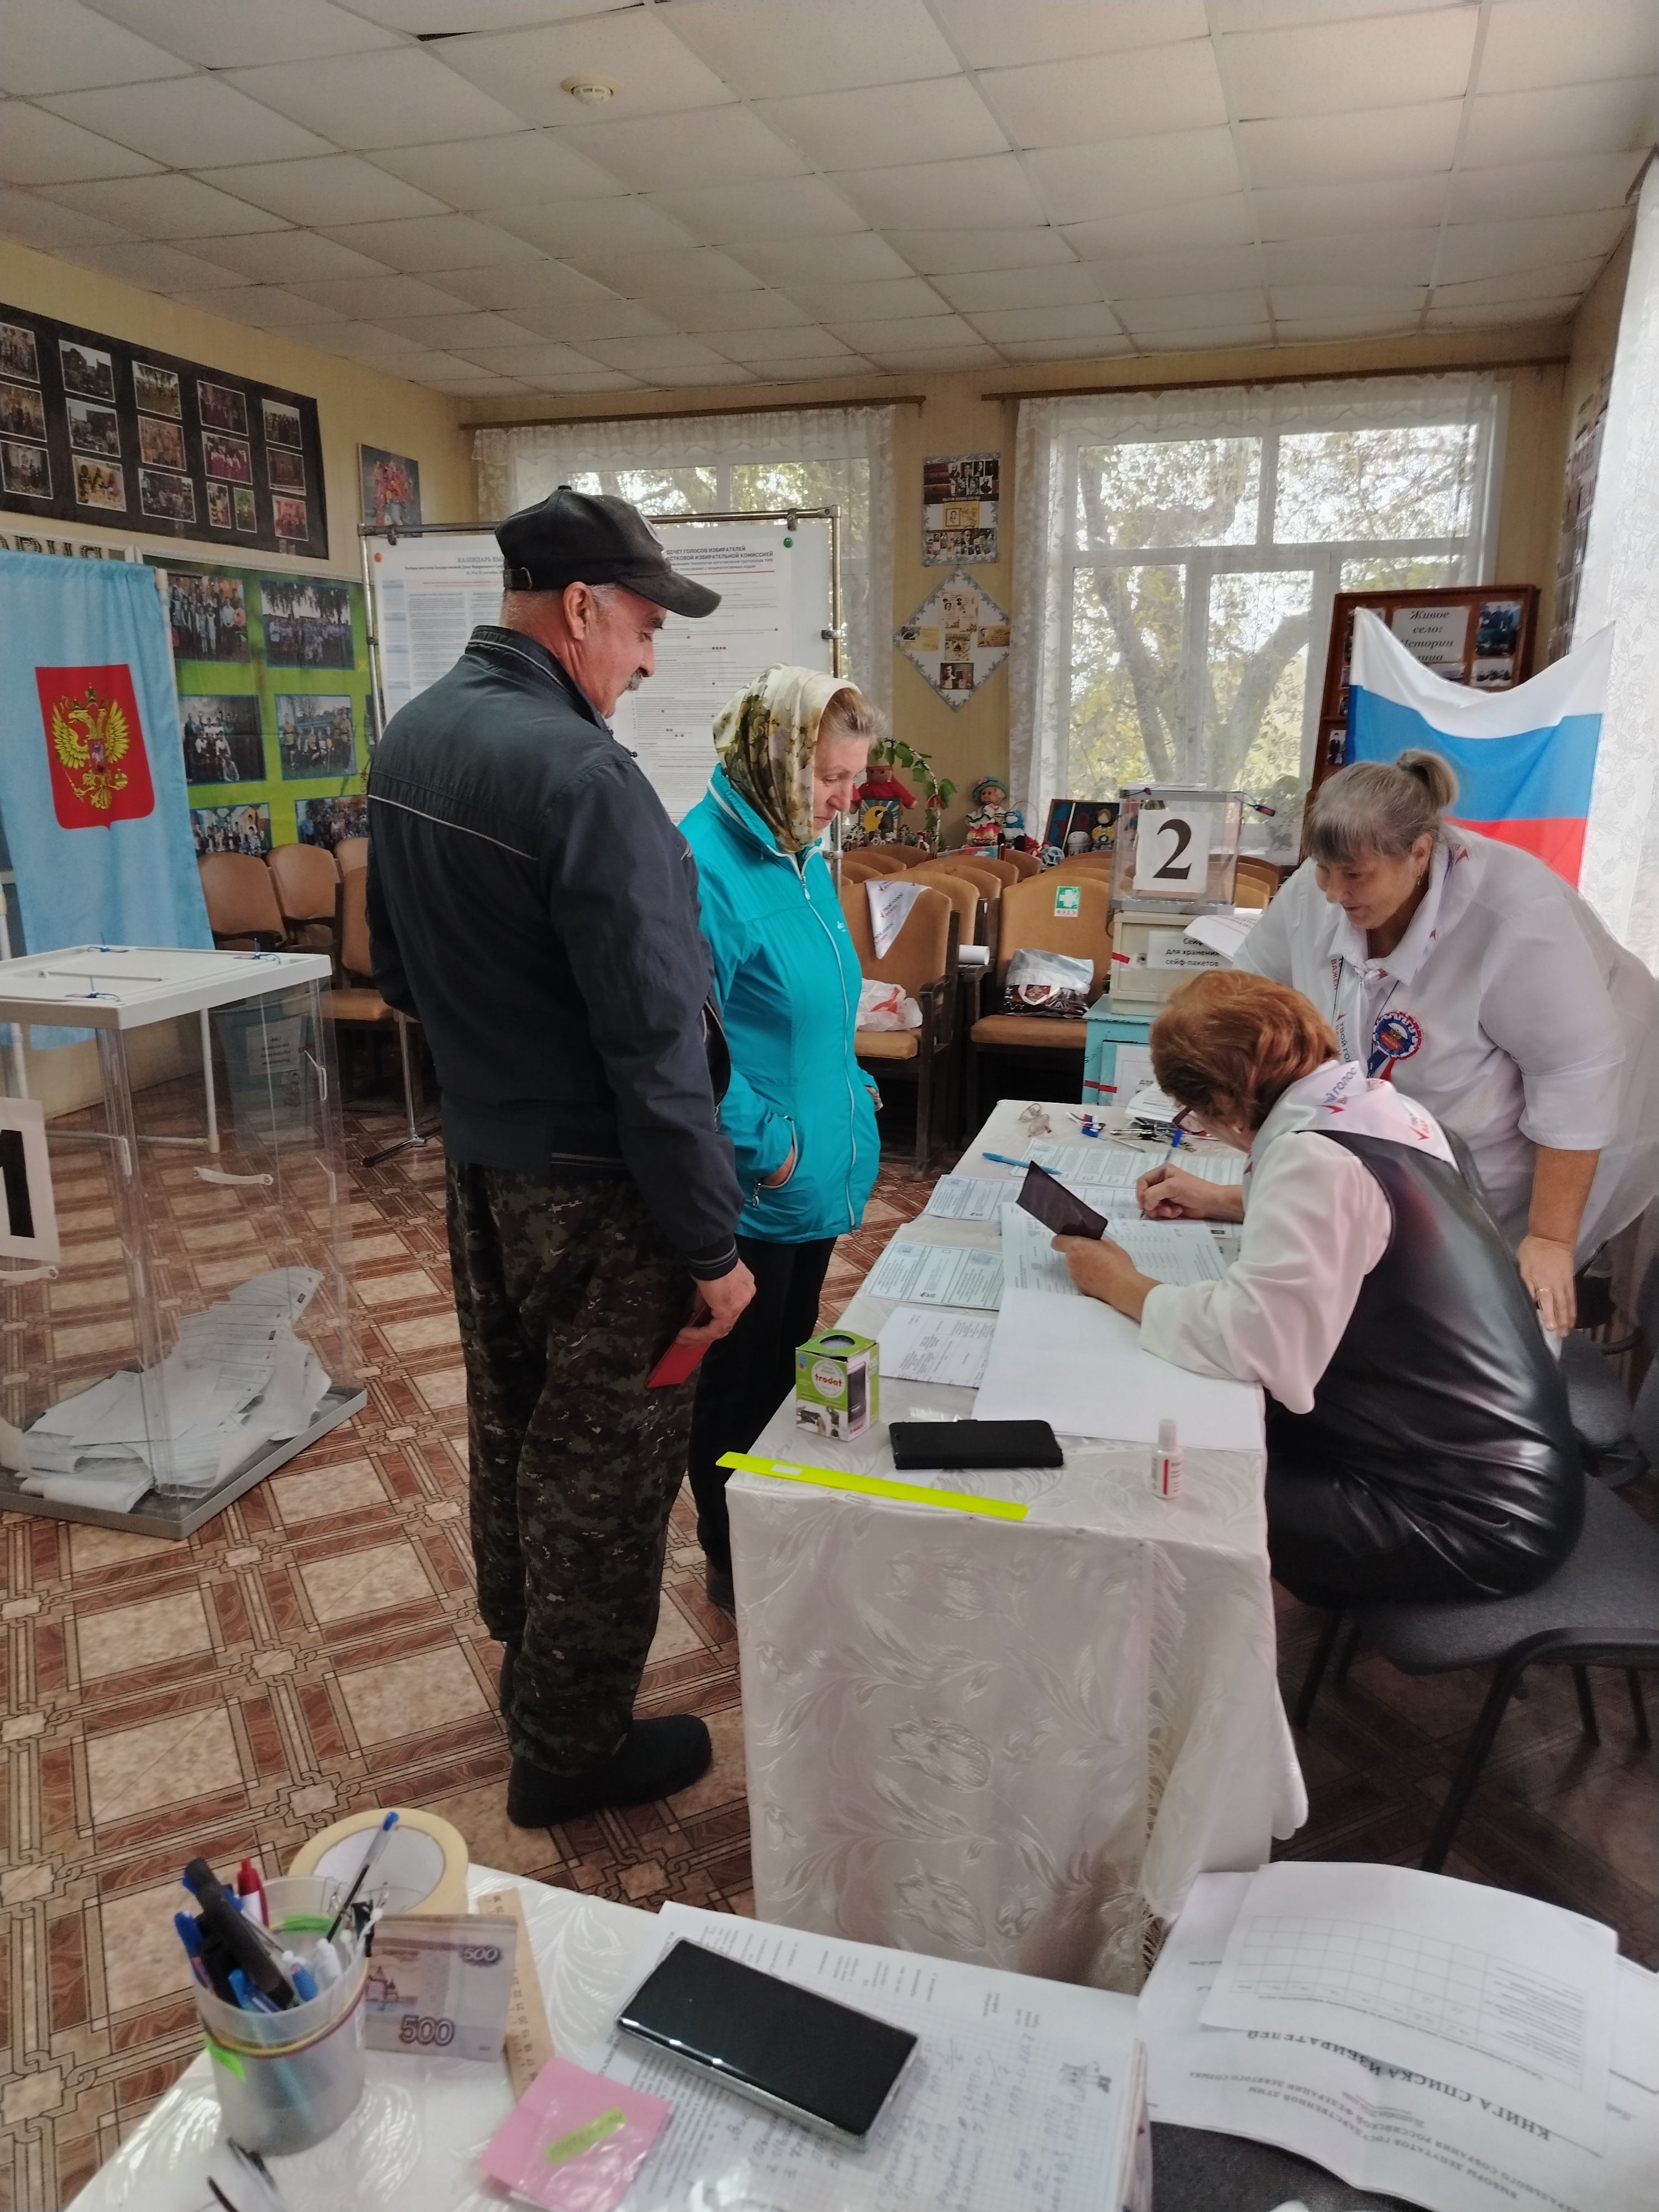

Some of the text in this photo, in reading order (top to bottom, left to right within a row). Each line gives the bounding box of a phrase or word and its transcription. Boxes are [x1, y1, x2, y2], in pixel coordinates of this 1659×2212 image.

[1409, 610, 1449, 619] Живое
[1152, 818, 1193, 880] 2
[1183, 938, 1203, 947] Сейф
[1165, 958, 1219, 967] сейф-пакетов
[1332, 1067, 1357, 1095] ГОЛОС
[0, 1129, 35, 1239] 1
[815, 1373, 842, 1387] trodat
[462, 1948, 497, 1961] 500
[399, 2013, 456, 2046] 500
[1246, 2030, 1382, 2077] ИЗБИРАТЕЛЕЙ
[1189, 2072, 1229, 2080] СОЗЫВА
[1230, 2074, 1285, 2087] ДЕВЯТОГО
[1248, 2086, 1281, 2098] ДУМЫ
[1389, 2068, 1472, 2102] СПИСКА
[1287, 2083, 1354, 2115] ФЕДЕРАЦИИ
[1282, 2094, 1390, 2143] ГОСУДАРСТВЕННОЙ
[1356, 2114, 1432, 2144] РОССИЙСКОЙ
[1479, 2098, 1550, 2142] КНИГА
[1394, 2137, 1463, 2171] ДЕПУТАТОВ
[1435, 2139, 1498, 2175] СОБРАНИЯ
[1467, 2167, 1519, 2200] ВЫБОРЫ
